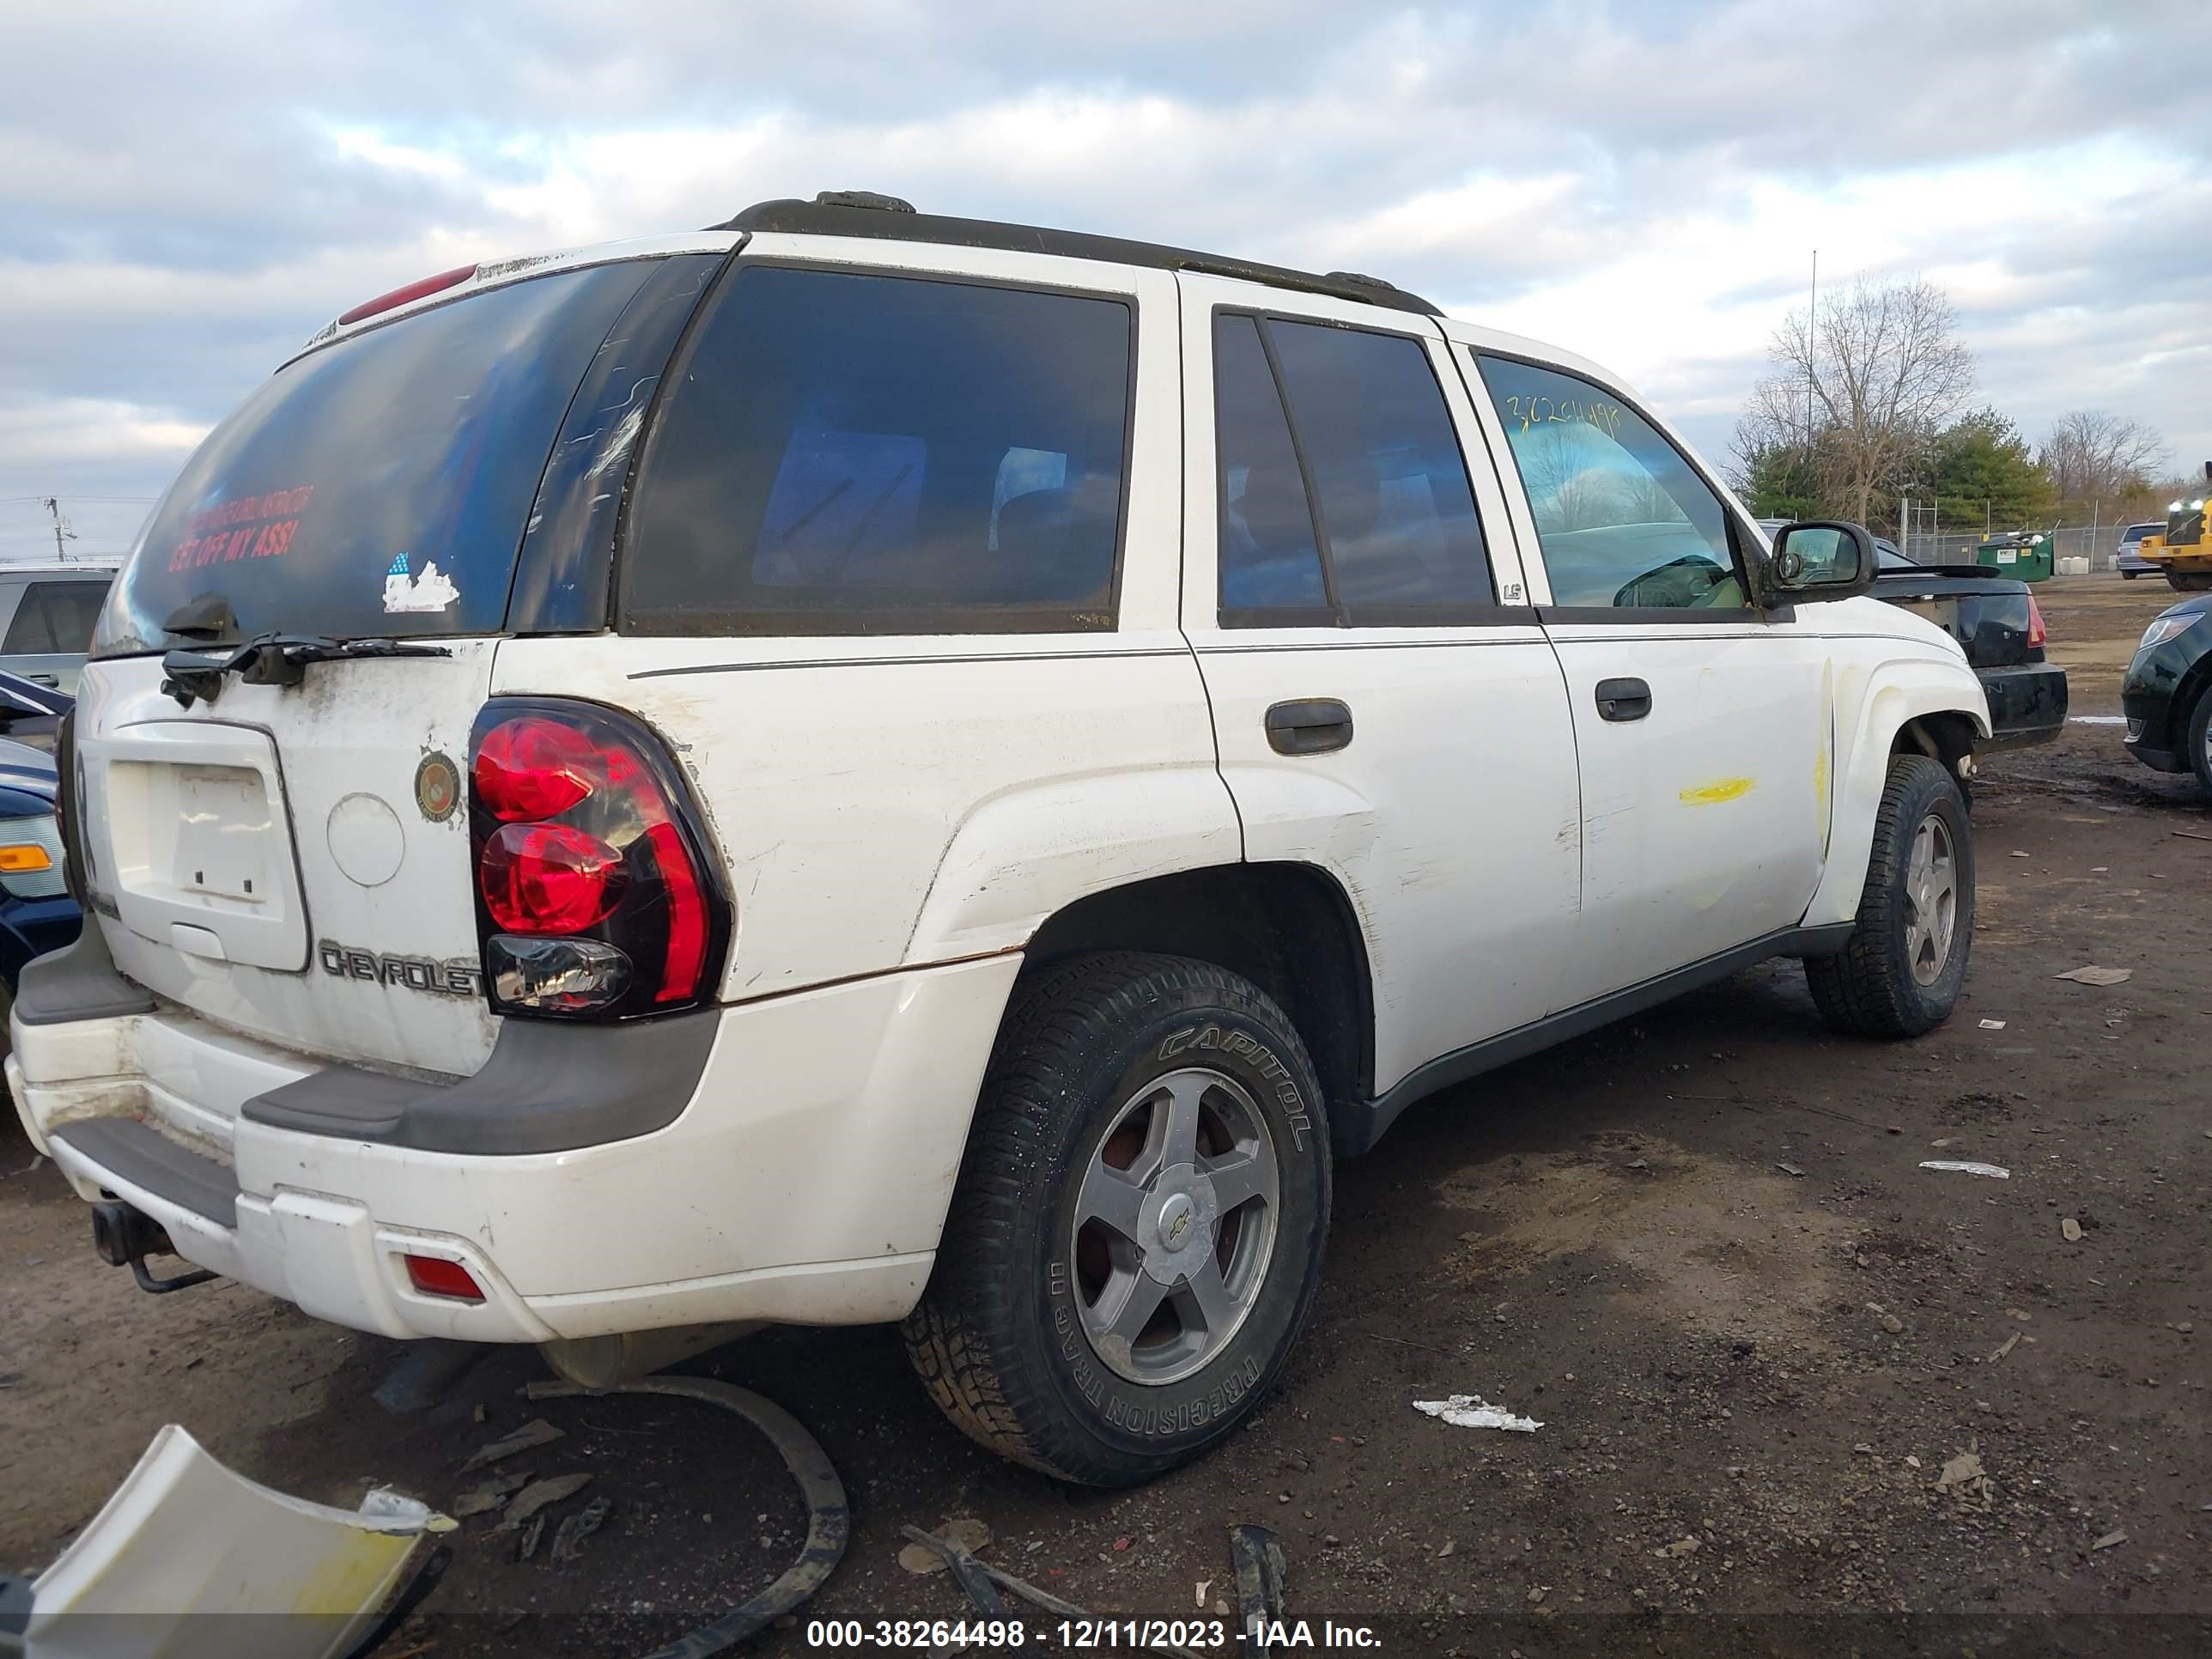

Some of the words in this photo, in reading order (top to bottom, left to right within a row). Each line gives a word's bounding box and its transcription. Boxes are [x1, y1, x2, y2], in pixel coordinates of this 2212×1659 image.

[195, 532, 230, 567] OFF
[223, 526, 257, 562] MY
[251, 520, 299, 557] ASS!
[1504, 583, 1522, 600] LS
[319, 946, 484, 998] CHEVROLET
[1158, 1027, 1311, 1152] CAPITOL
[1105, 1356, 1260, 1436] PRECISION
